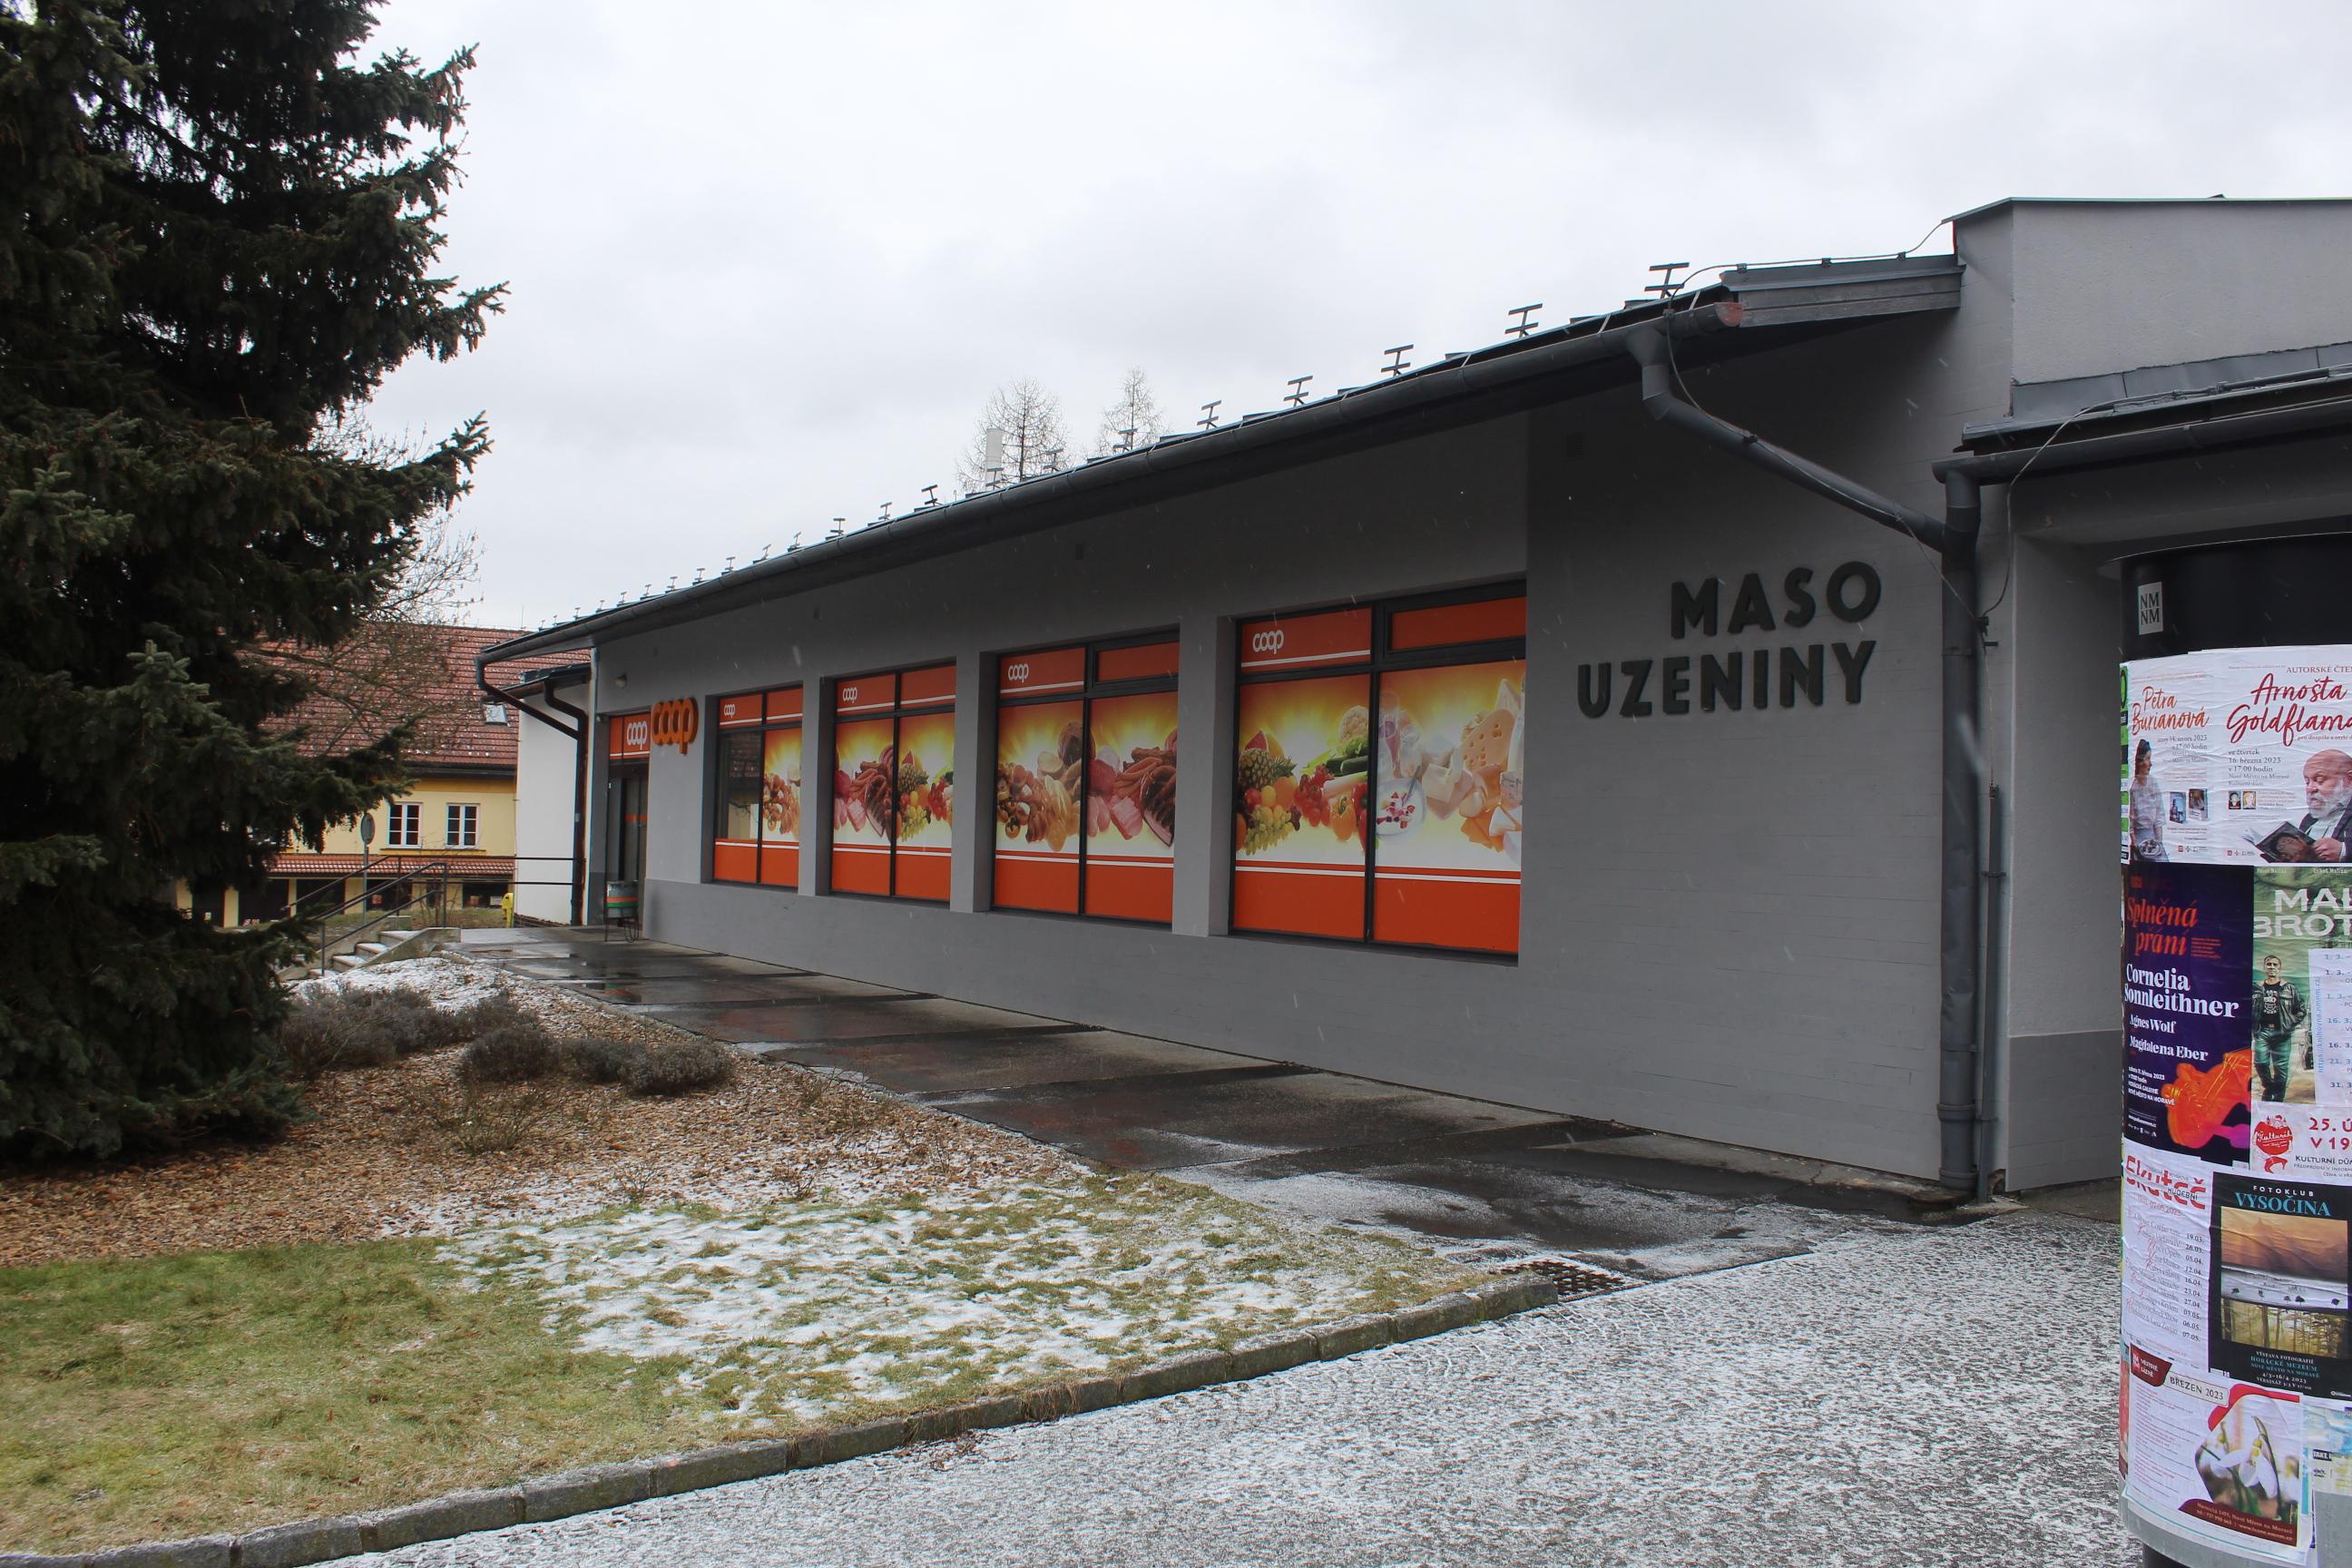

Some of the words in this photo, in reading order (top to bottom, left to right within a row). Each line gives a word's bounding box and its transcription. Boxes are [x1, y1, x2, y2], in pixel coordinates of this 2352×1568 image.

[1671, 561, 1882, 640] MASO
[2141, 592, 2160, 610] NM
[2141, 609, 2160, 625] NM
[1252, 630, 1284, 654] coop
[1007, 663, 1029, 683] coop
[2287, 664, 2332, 672] AUTORSKÉ
[2334, 664, 2352, 672] ČTE
[1577, 640, 1877, 719] UZENINY
[2250, 672, 2348, 705] Arnošta
[842, 687, 858, 704] coop
[2142, 685, 2177, 712] Petra
[723, 704, 736, 718] coop
[2132, 702, 2210, 736] Burianová
[626, 720, 648, 750] coop
[651, 697, 699, 755] coop
[2127, 897, 2199, 928] Splněná
[2134, 926, 2190, 956] přání
[2126, 963, 2191, 992] Cornelia
[2124, 983, 2239, 1018] Sonnleithner
[2129, 1014, 2150, 1029] Agnes
[2150, 1018, 2177, 1034] Wolf
[2129, 1035, 2175, 1056] Magdalena
[2176, 1045, 2209, 1062] Eber
[2308, 1117, 2337, 1132] 25.
[2253, 1185, 2314, 1197] FOTOKLUB
[2235, 1192, 2331, 1217] VYSOČINA
[2187, 1233, 2205, 1243] 19.03.
[2185, 1243, 2204, 1254] 26.03.
[2185, 1288, 2201, 1298] 23.04.
[2183, 1320, 2201, 1331] 06.05.
[2182, 1332, 2200, 1342] 07.05.
[2206, 1388, 2223, 1400] 2023
